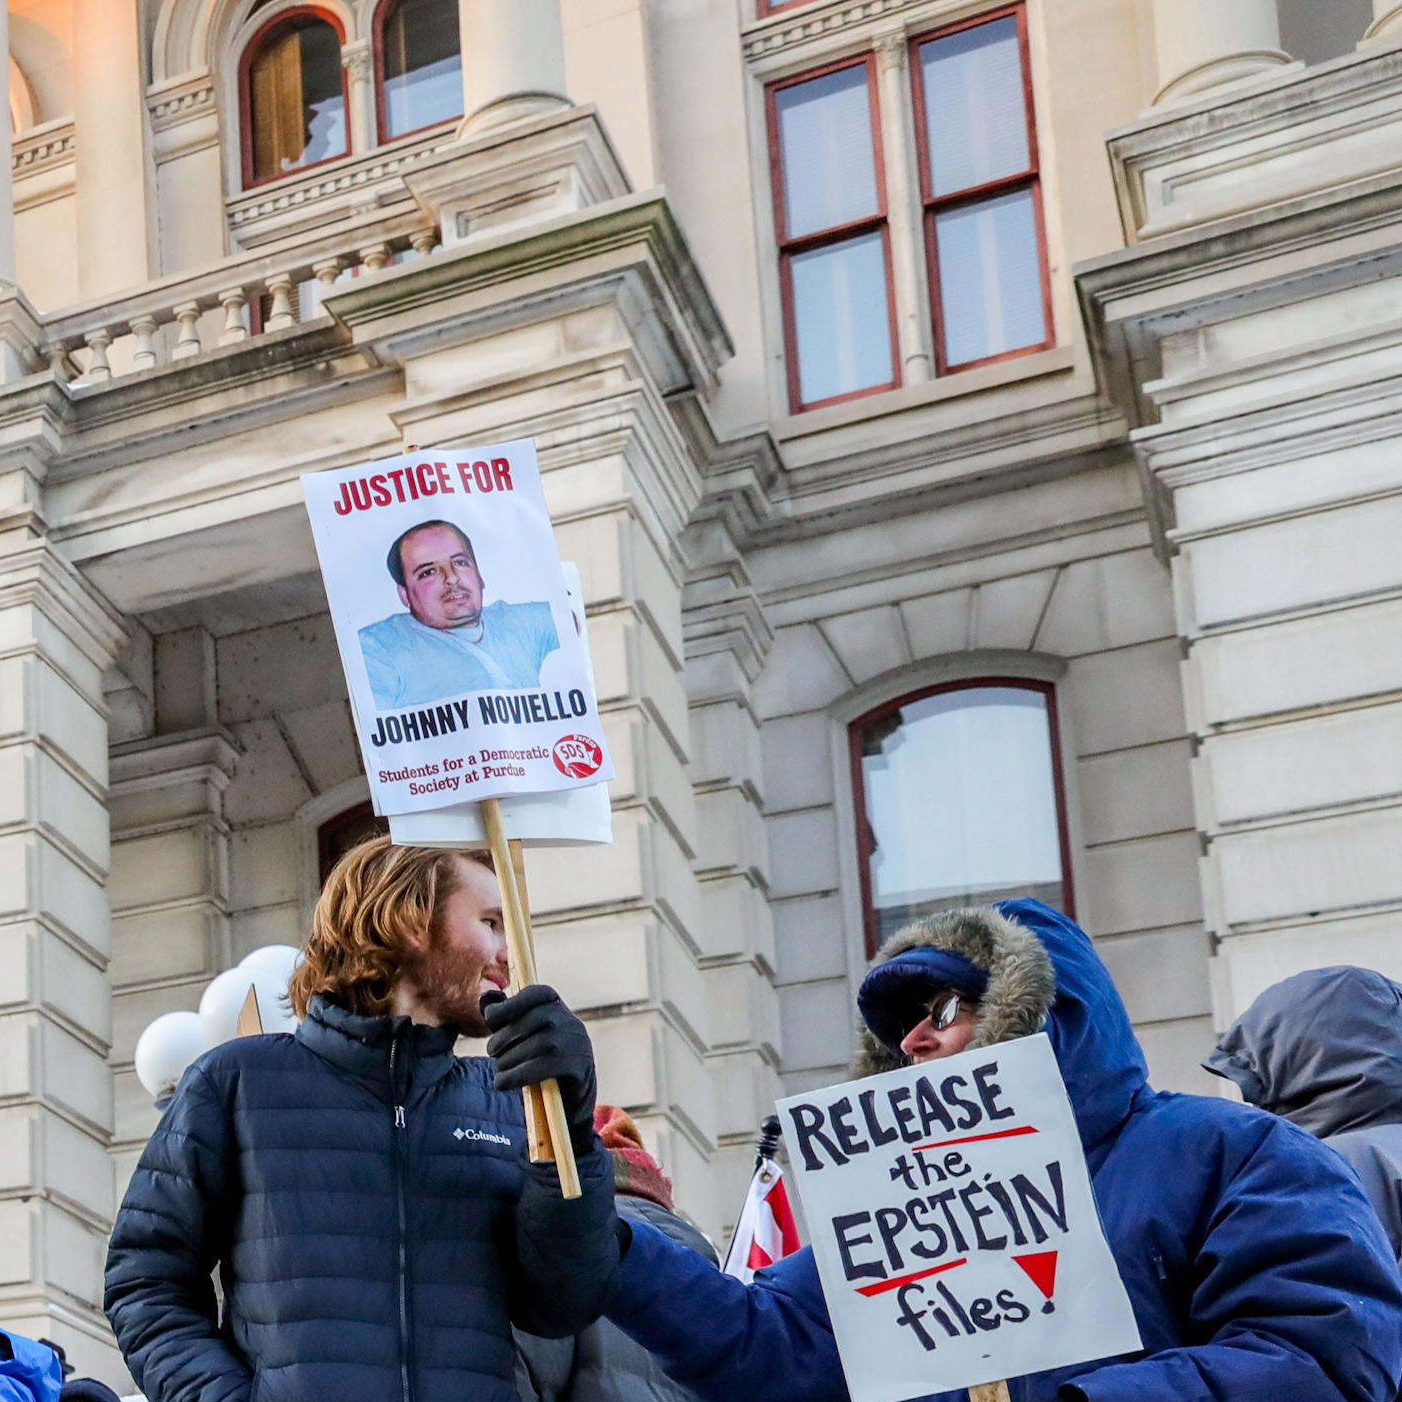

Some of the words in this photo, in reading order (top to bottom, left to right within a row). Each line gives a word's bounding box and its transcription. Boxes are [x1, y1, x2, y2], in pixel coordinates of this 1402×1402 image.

[334, 462, 455, 516] JUSTICE
[457, 457, 513, 494] FOR
[371, 699, 469, 747] JOHNNY
[478, 688, 588, 725] NOVIELLO
[378, 763, 440, 784] Students
[442, 756, 464, 772] for
[468, 756, 477, 766] a
[479, 746, 549, 763] Democratic
[560, 743, 585, 760] SDS
[409, 775, 461, 796] Society
[464, 771, 480, 784] at
[482, 764, 525, 780] Purdue
[788, 1060, 1016, 1172] RELEASE
[464, 1128, 512, 1146] Columbia
[889, 1150, 972, 1190] the
[832, 1160, 1070, 1281] EPSTEIN
